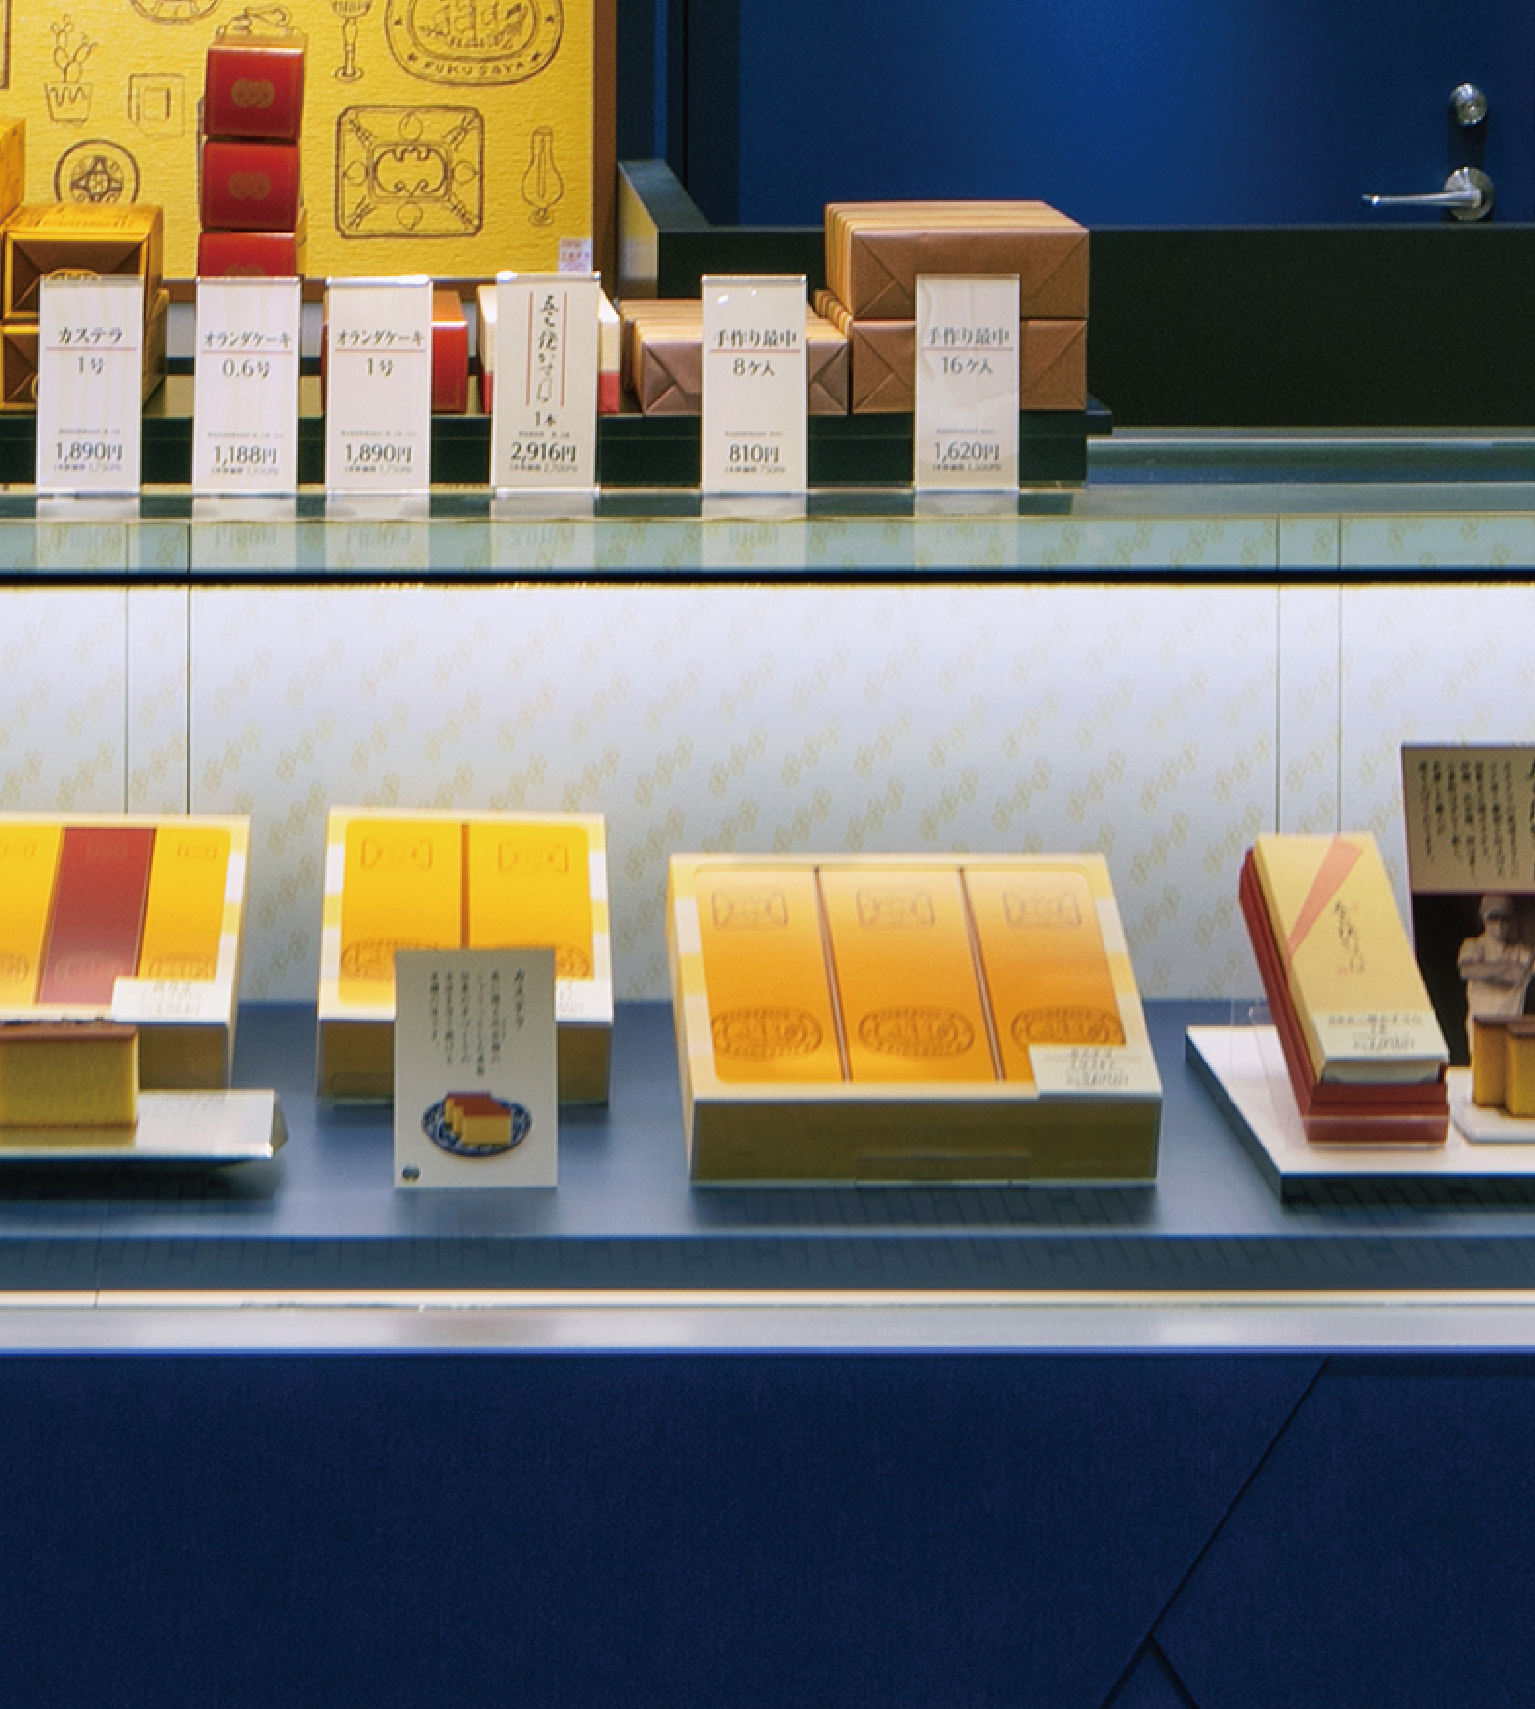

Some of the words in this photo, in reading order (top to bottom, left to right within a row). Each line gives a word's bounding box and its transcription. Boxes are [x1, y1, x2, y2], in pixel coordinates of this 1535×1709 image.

[59, 326, 123, 346] カステラ
[204, 330, 292, 348] オランダケーキ
[337, 328, 424, 347] オランダケーキ
[77, 357, 105, 376] 1号
[222, 358, 270, 378] 0.6号
[366, 357, 394, 377] 1号
[56, 443, 123, 464] 1,890円
[214, 445, 276, 467] 1,188円
[345, 443, 412, 465] 1,890円
[511, 441, 576, 464] 2,916円
[729, 444, 779, 463] 810円
[933, 442, 1000, 463] 1,620円
